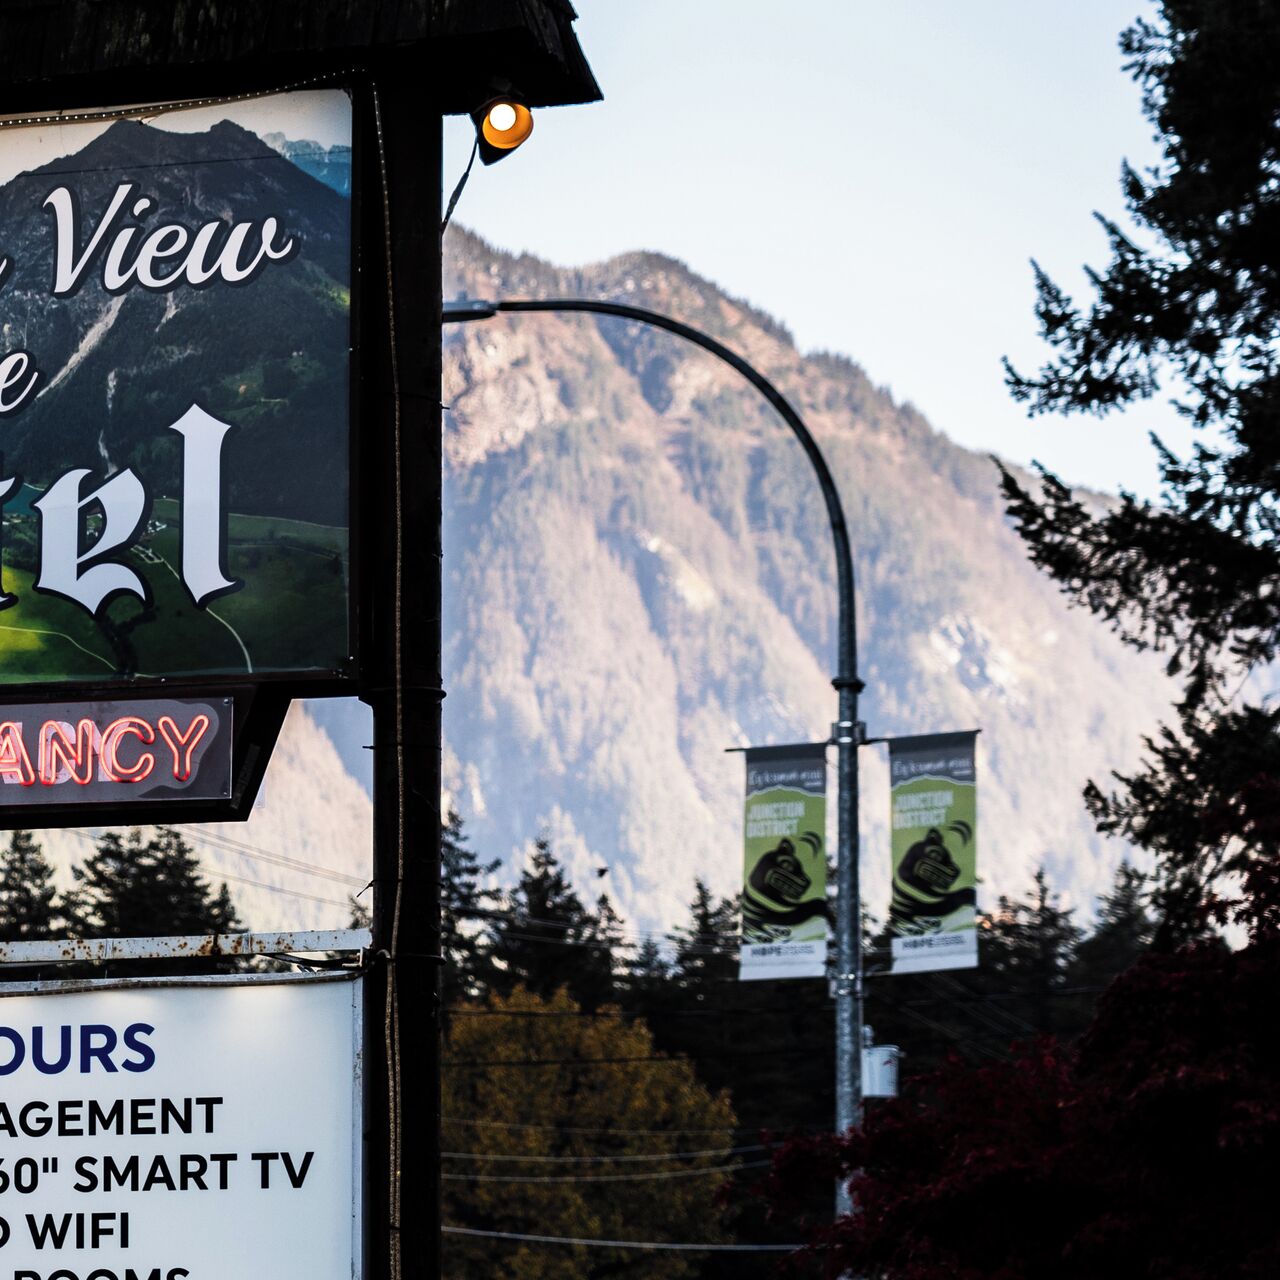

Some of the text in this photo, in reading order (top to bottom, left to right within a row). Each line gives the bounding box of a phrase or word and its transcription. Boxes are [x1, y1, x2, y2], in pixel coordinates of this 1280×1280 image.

[44, 183, 293, 297] View
[73, 1153, 238, 1193] SMART
[251, 1151, 315, 1190] TV
[24, 1212, 129, 1250] WIFI
